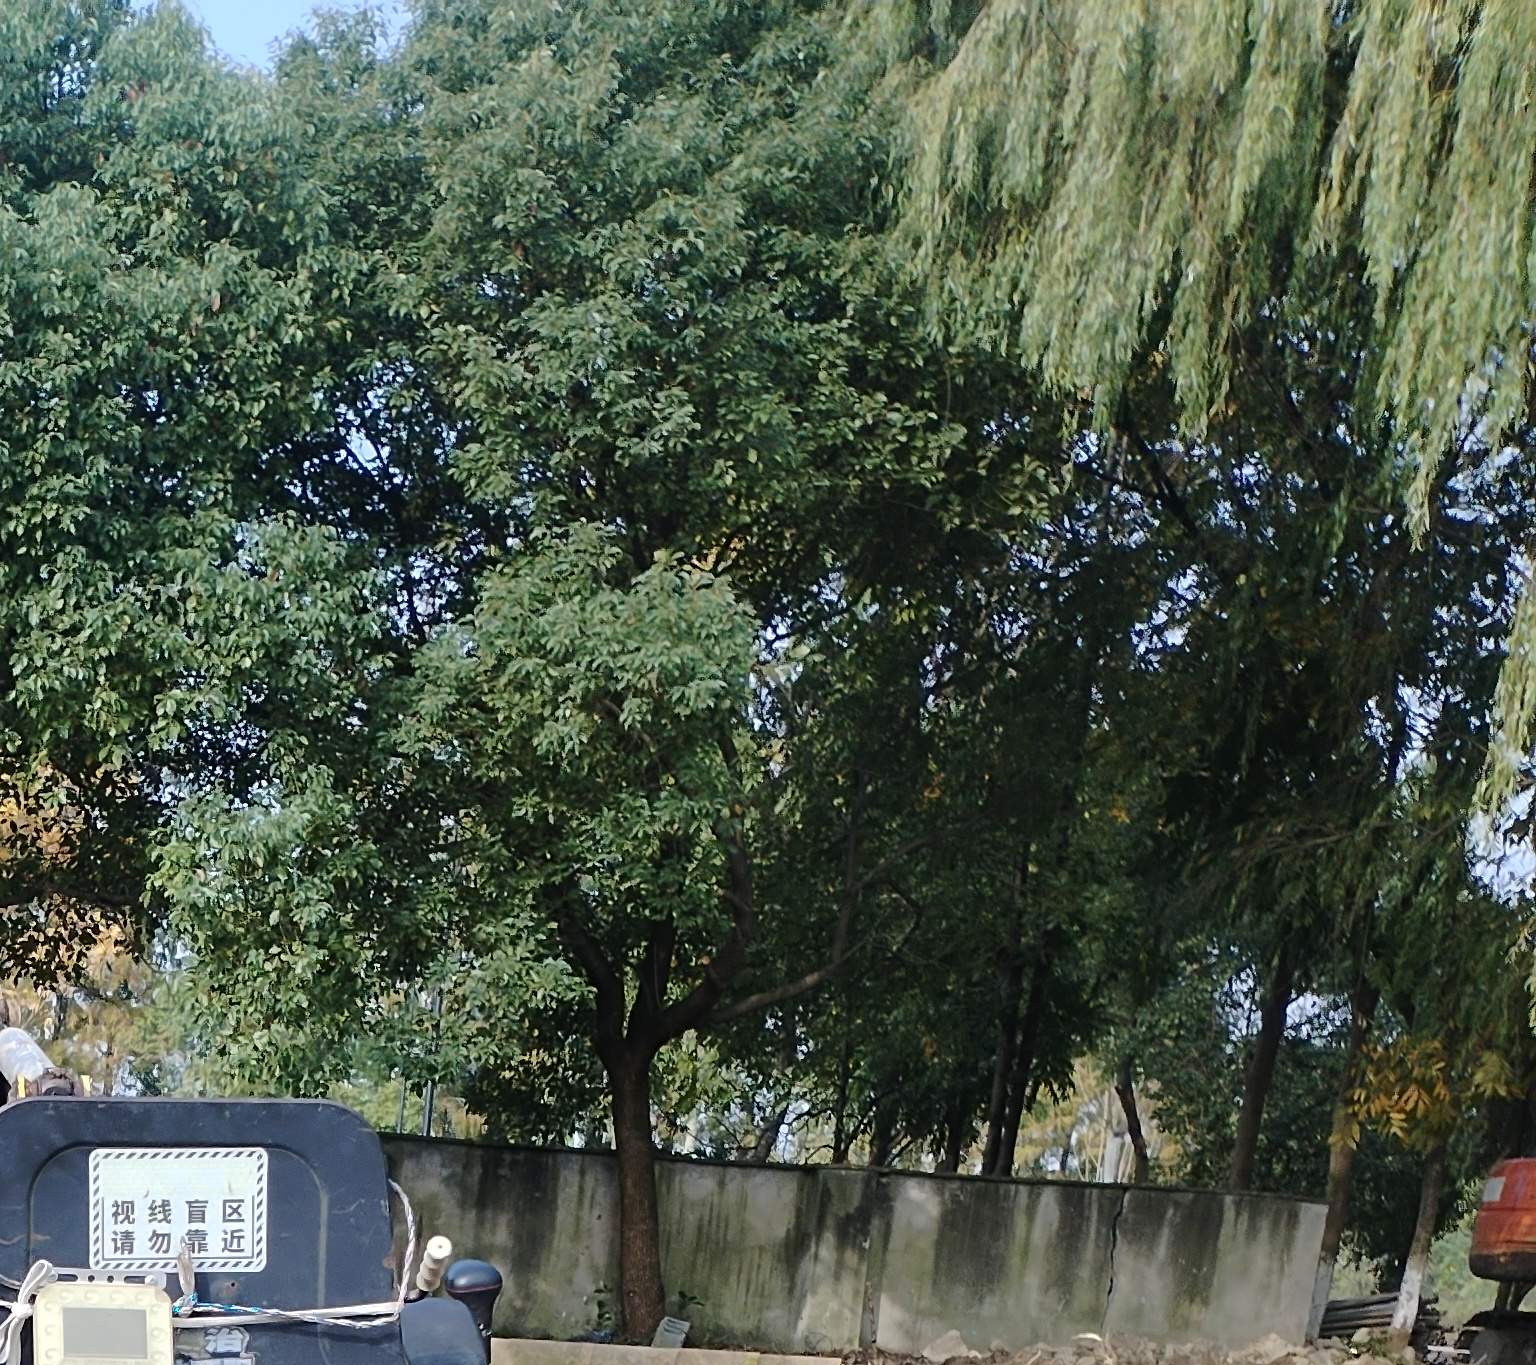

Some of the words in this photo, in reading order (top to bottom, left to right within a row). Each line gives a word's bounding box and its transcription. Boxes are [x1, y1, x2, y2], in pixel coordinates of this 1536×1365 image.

[111, 1199, 245, 1225] 视线盲区
[111, 1229, 245, 1255] 请勿靠近
